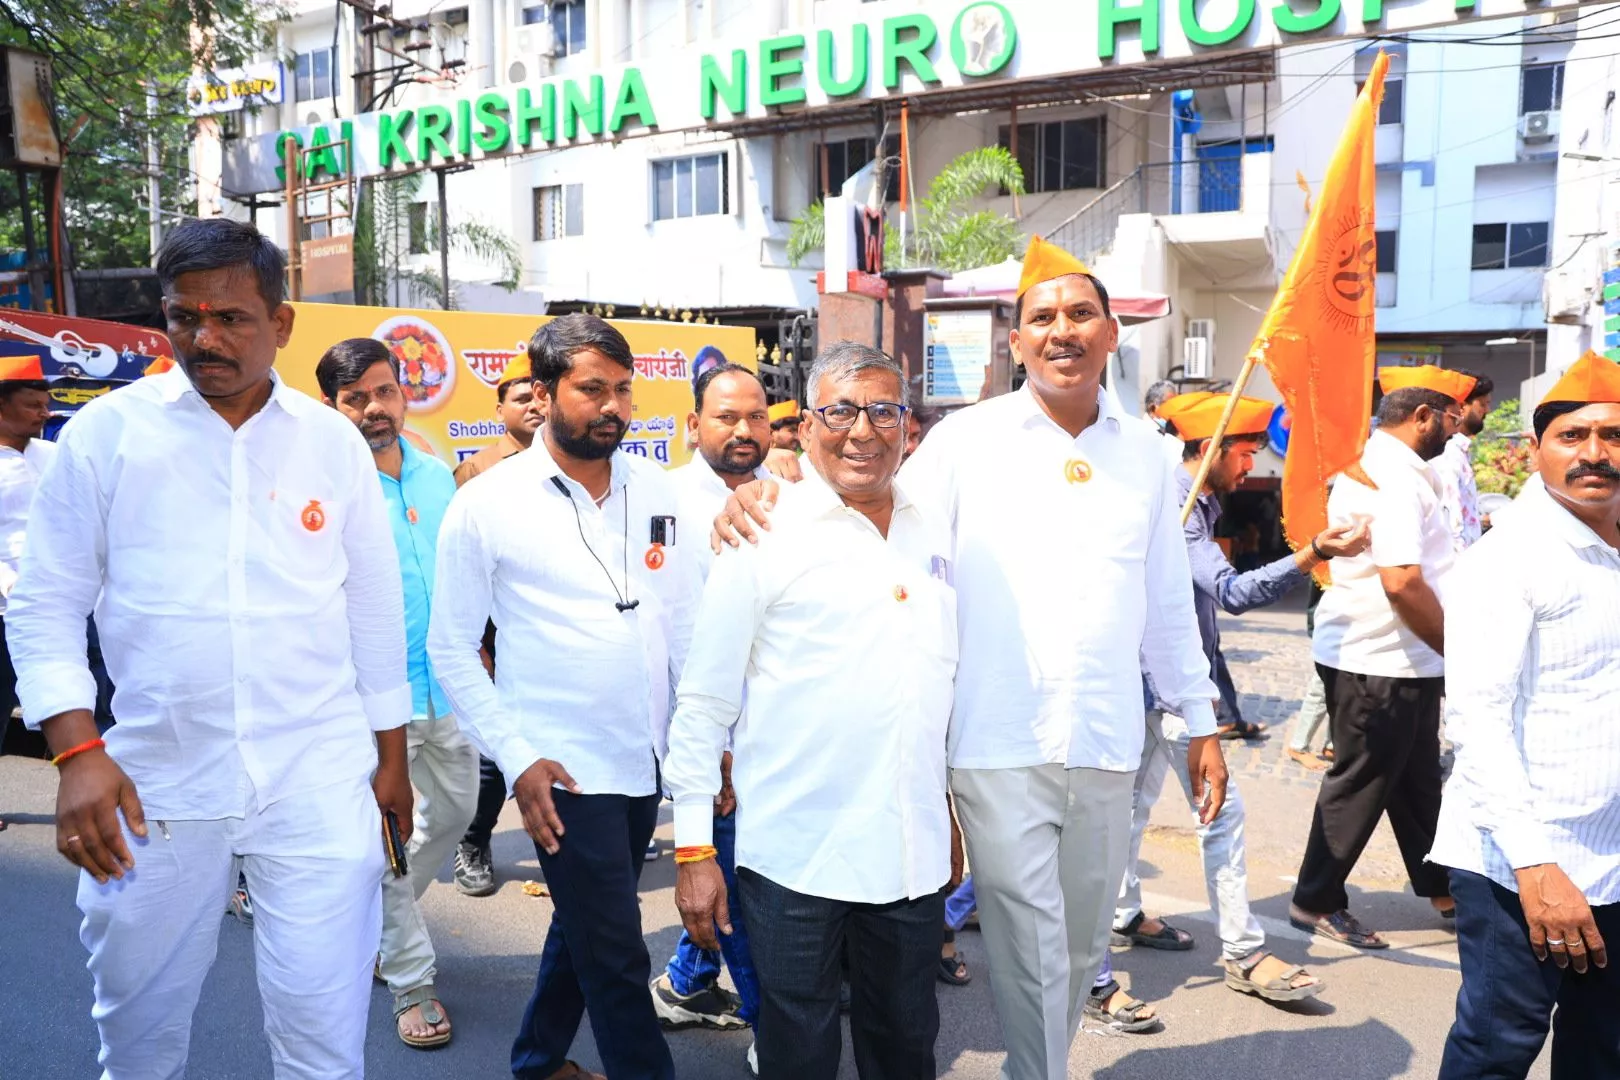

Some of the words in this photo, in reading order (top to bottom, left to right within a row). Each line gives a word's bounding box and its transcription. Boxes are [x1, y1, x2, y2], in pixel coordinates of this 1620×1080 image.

[275, 120, 352, 184] SAI
[379, 68, 658, 168] KRISHNA
[701, 1, 1017, 118] NEURO
[449, 422, 505, 437] Shobha
